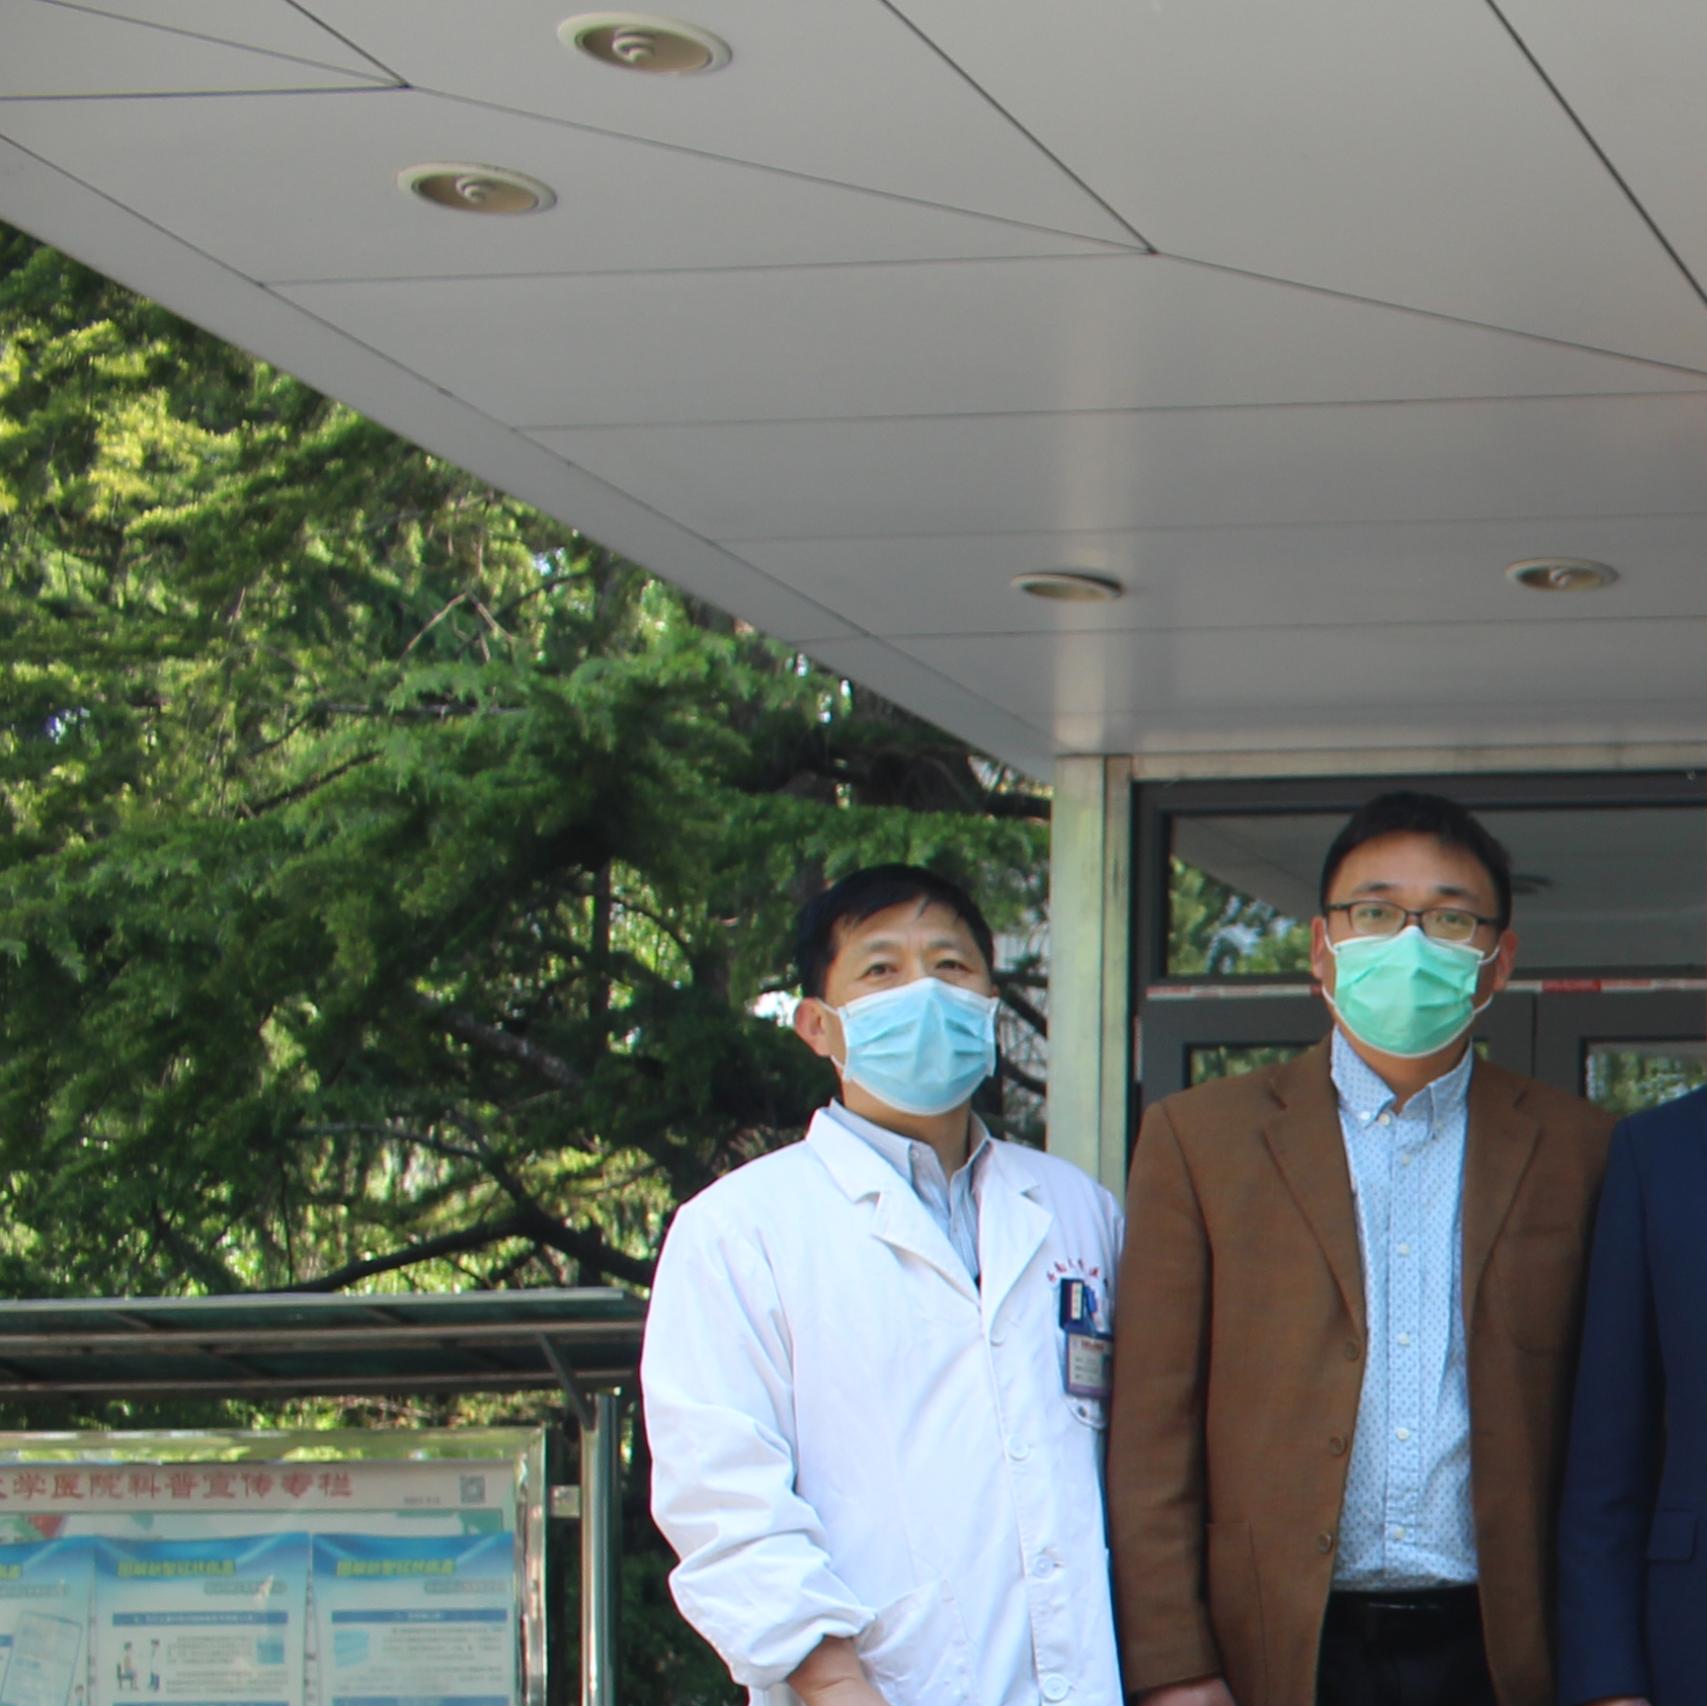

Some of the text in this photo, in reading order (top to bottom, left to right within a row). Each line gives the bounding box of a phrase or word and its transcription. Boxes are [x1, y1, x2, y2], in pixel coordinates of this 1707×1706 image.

[0, 1470, 354, 1501] 学医院科普宣传专栏
